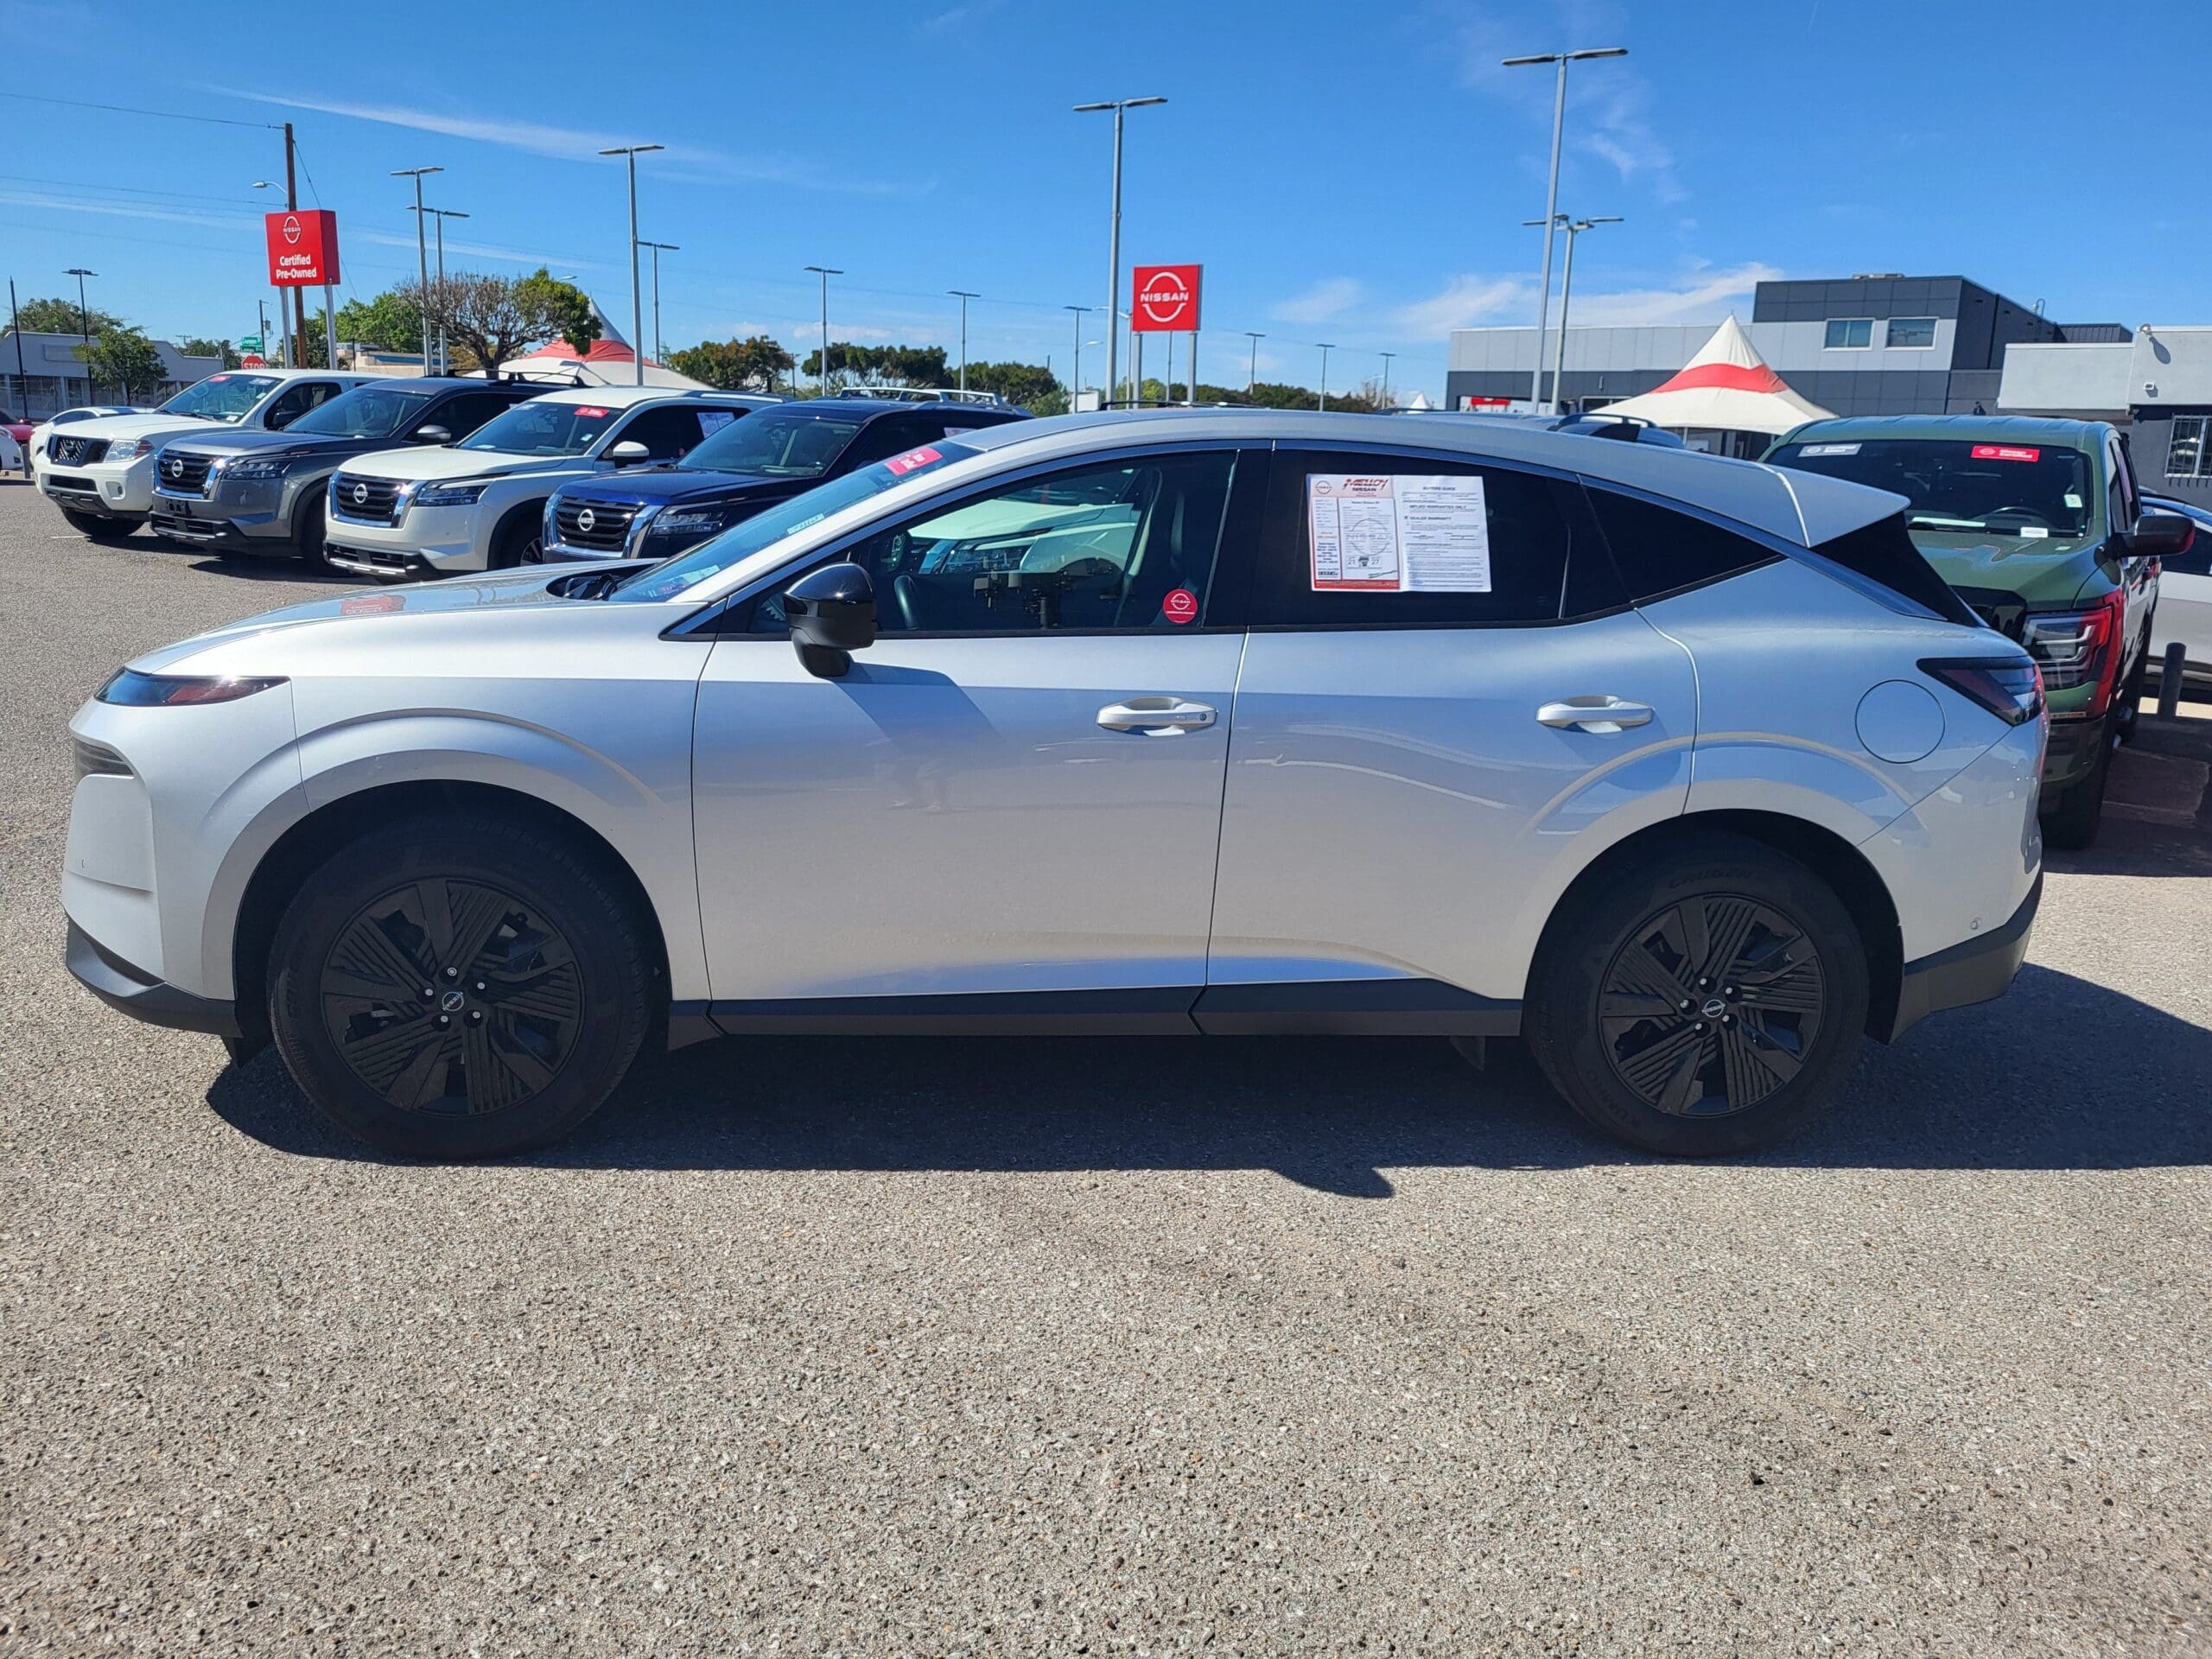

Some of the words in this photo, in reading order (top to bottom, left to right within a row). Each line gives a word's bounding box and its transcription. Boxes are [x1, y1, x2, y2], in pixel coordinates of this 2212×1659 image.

[280, 254, 311, 266] Certified
[276, 267, 317, 279] Pre-Owned
[1141, 292, 1189, 302] NISSAN
